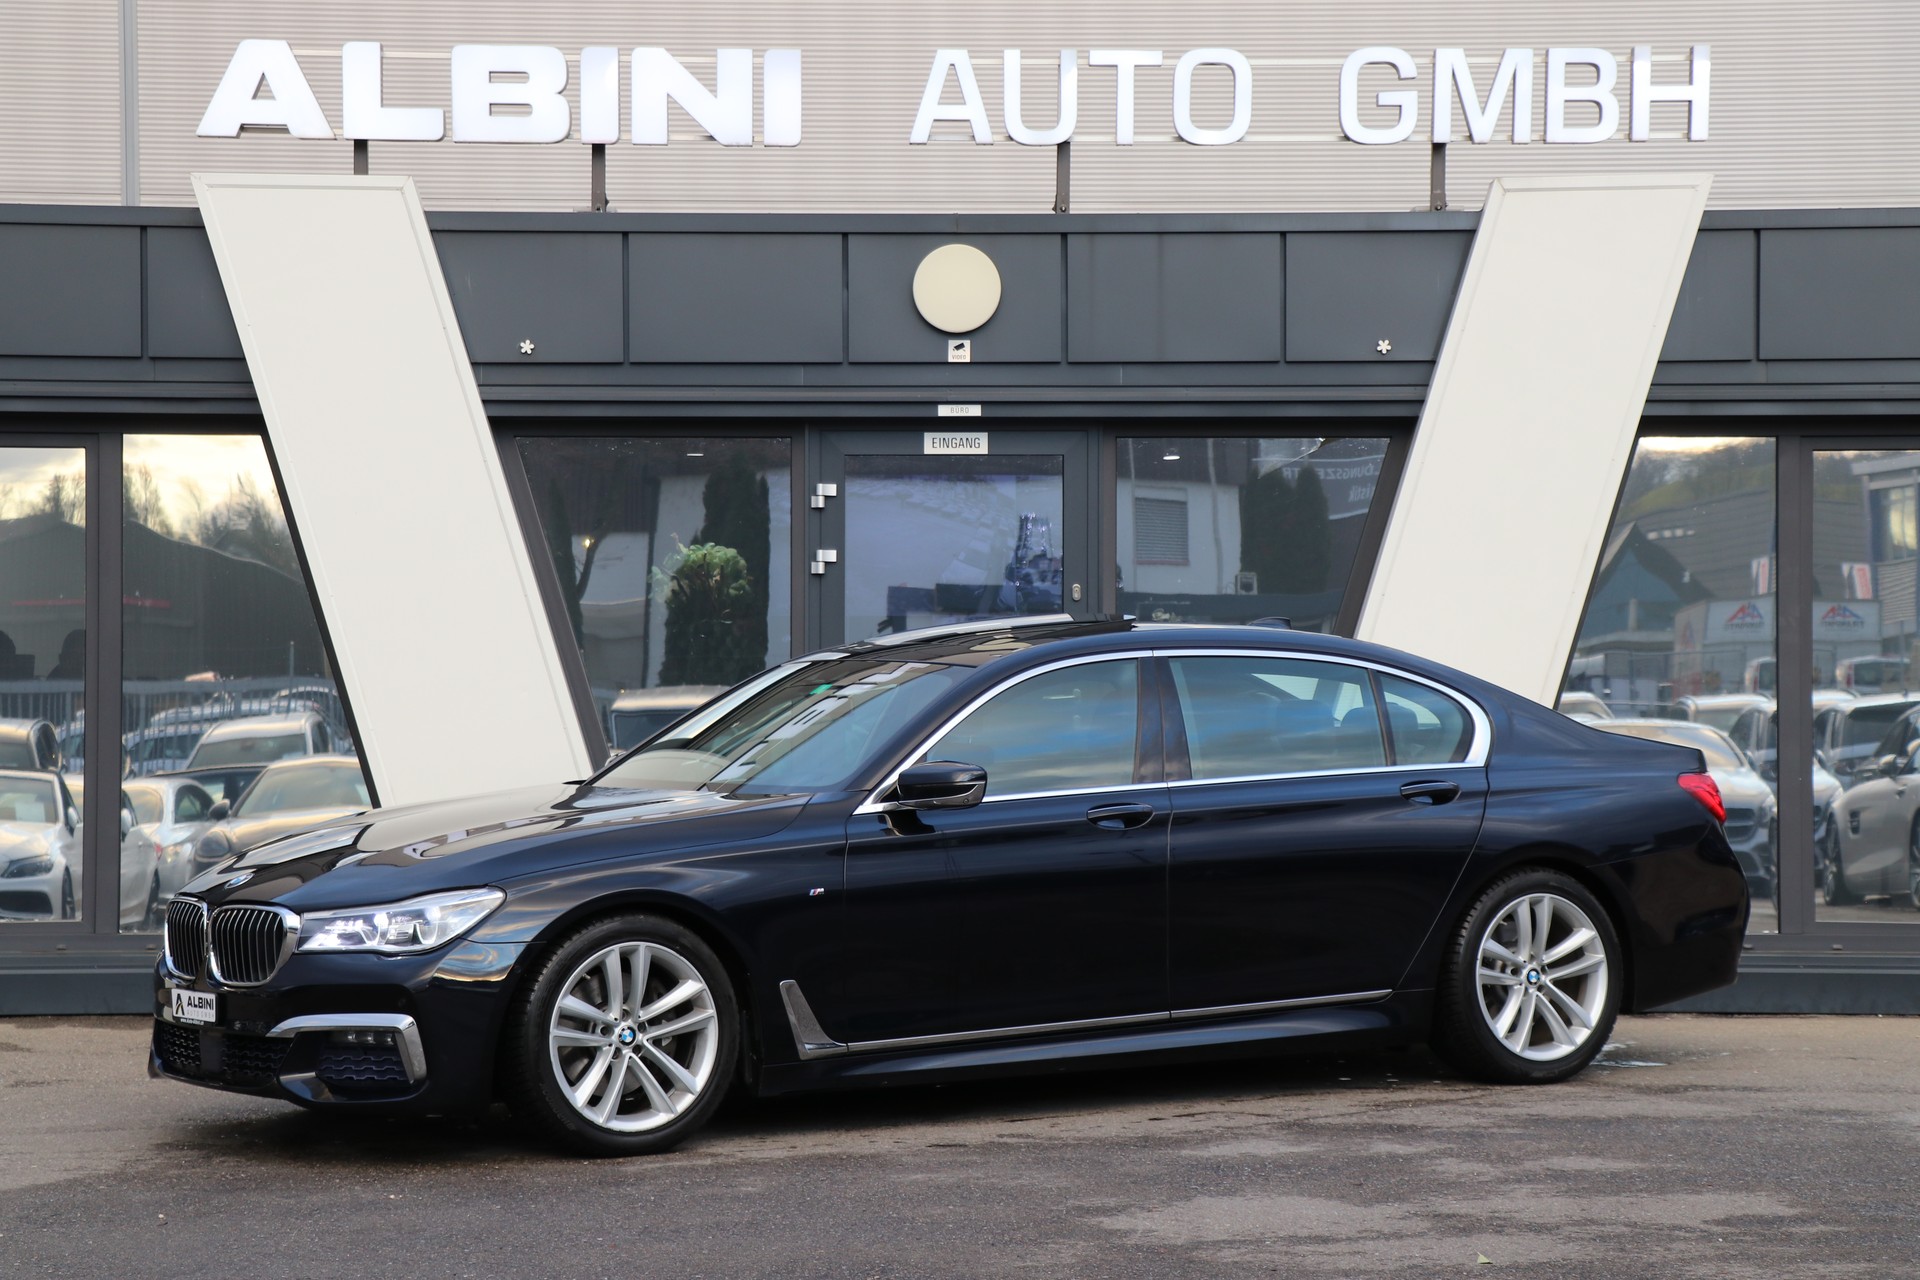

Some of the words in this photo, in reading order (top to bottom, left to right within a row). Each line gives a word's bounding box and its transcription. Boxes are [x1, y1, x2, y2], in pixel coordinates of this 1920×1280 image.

[196, 39, 802, 147] ALBINI
[909, 47, 1253, 146] AUTO
[1339, 45, 1712, 145] GMBH
[932, 437, 981, 449] EINGANG
[187, 996, 214, 1010] ALBINI
